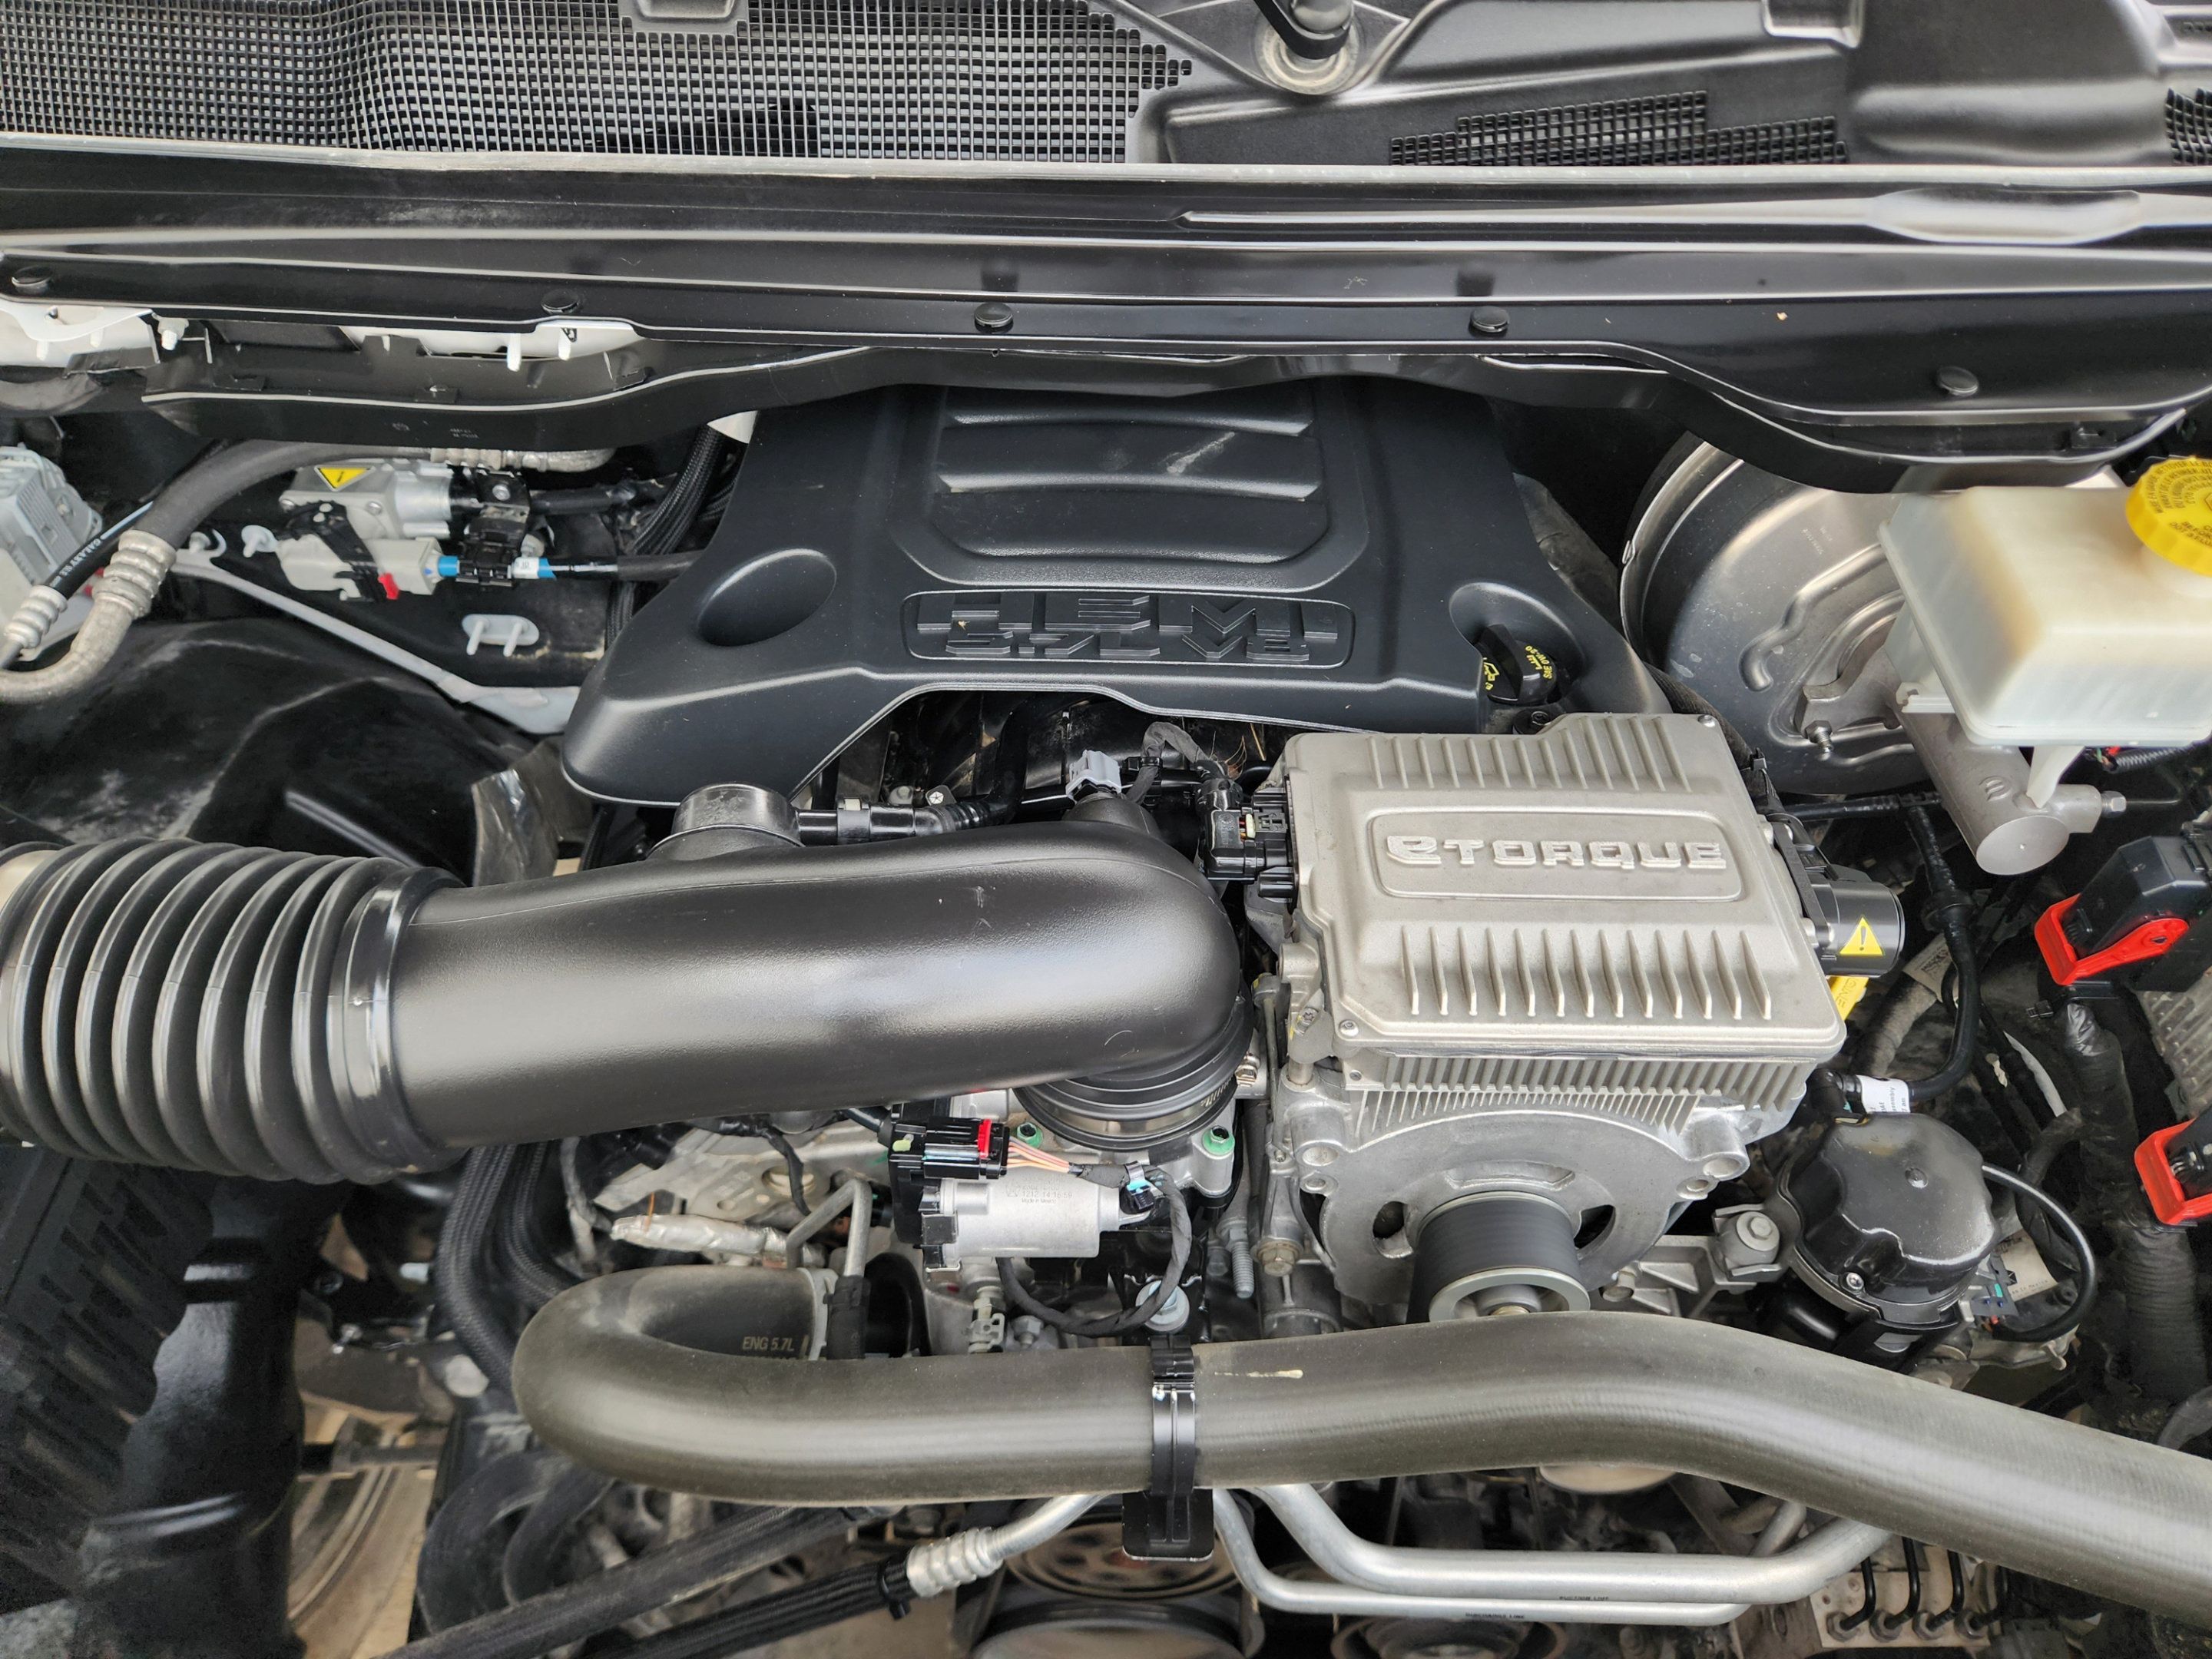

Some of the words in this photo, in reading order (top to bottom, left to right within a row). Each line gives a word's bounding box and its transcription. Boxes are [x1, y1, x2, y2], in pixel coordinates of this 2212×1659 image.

[917, 591, 1338, 640] HEMI
[945, 631, 1160, 657] 5.7L
[1182, 634, 1309, 662] V8
[1525, 645, 1550, 665] 0W-20
[1543, 665, 1553, 680] SAE
[1386, 835, 1727, 869] eTORQUE
[742, 1336, 768, 1351] ENG
[770, 1336, 795, 1352] 5.7L
